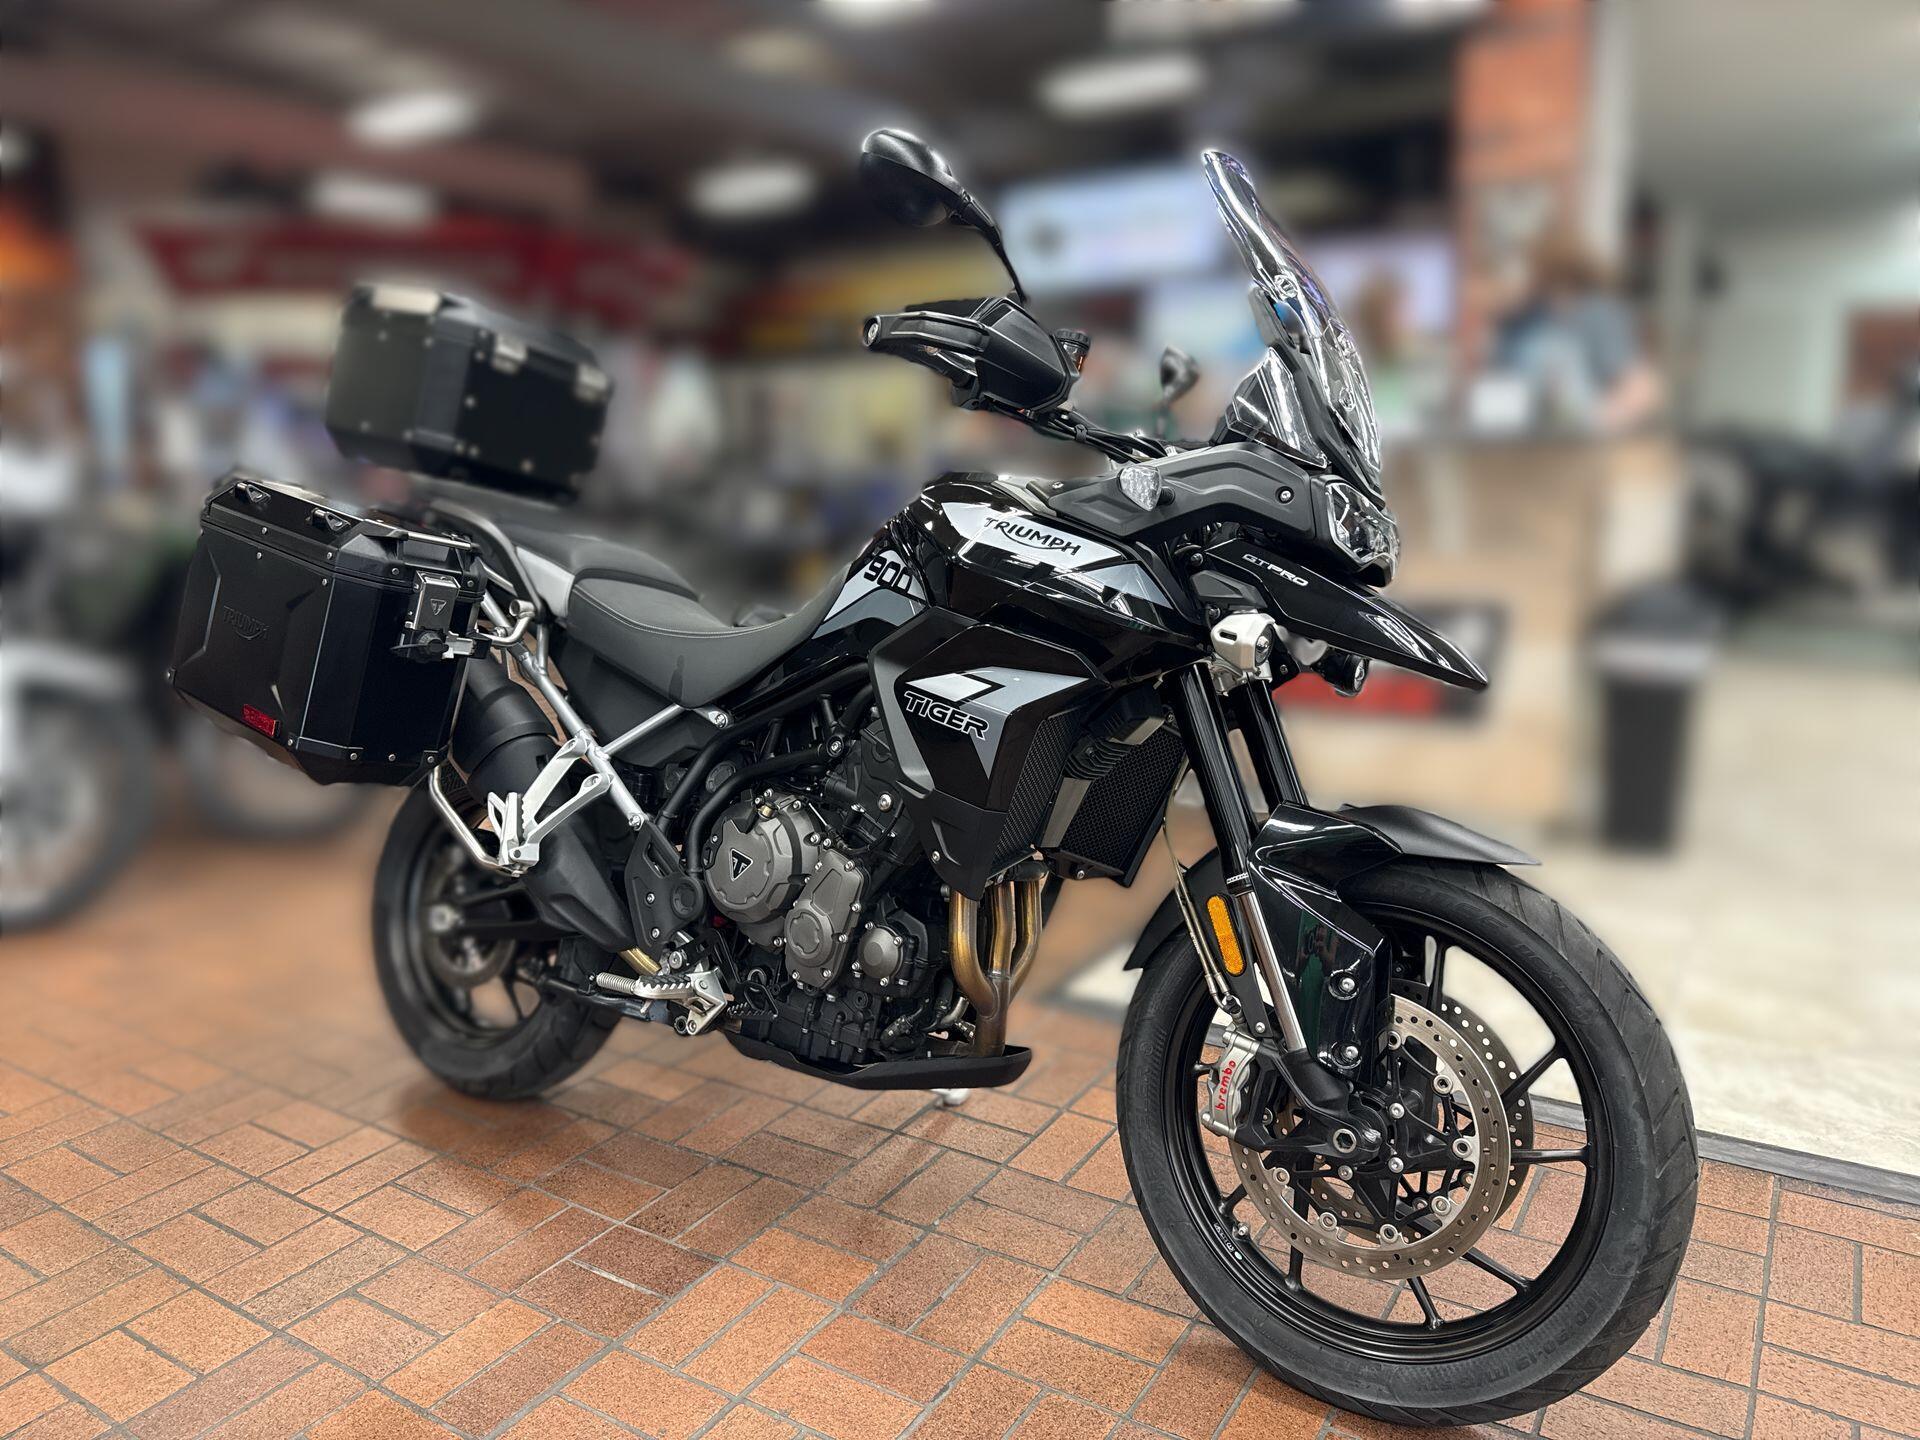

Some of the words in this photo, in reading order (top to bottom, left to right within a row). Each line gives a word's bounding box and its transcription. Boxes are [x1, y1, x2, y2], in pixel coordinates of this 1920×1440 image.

[984, 516, 1081, 555] TRIUMPH
[863, 552, 912, 592] 900
[904, 690, 989, 740] TIGER
[1215, 1060, 1236, 1110] brembo
